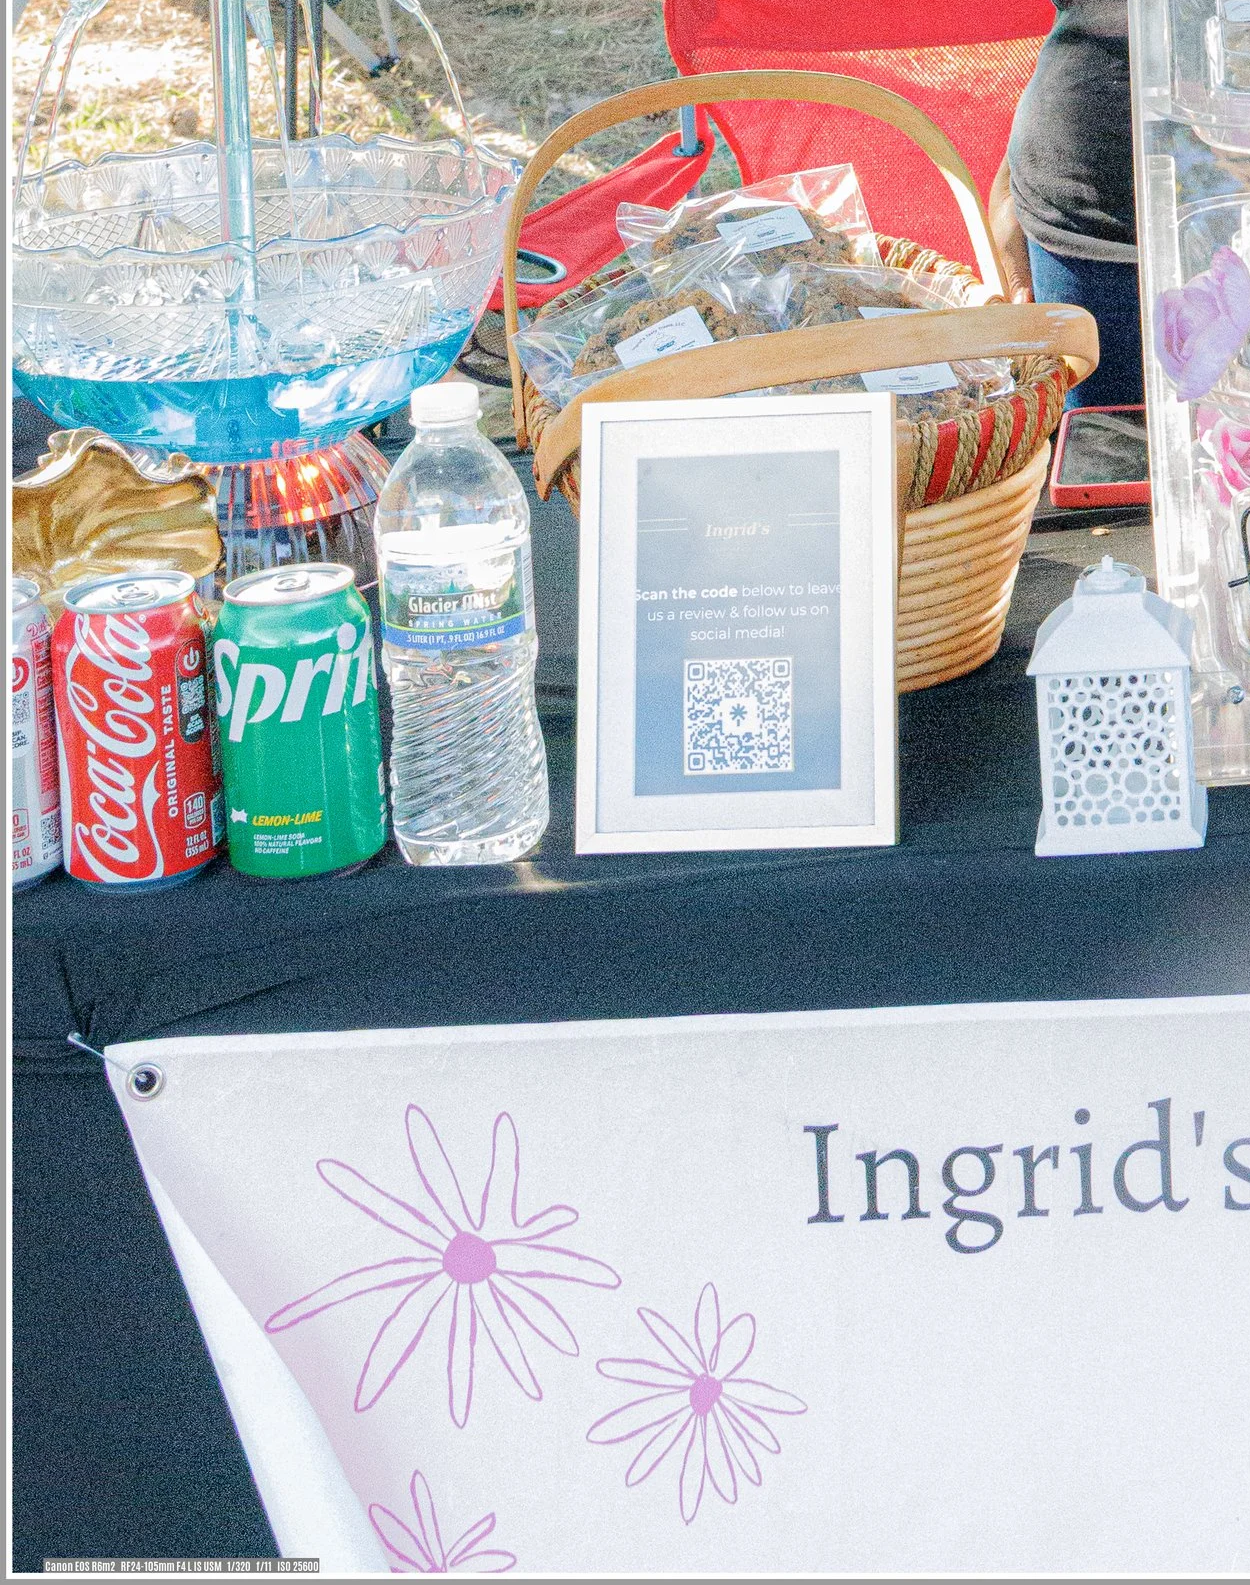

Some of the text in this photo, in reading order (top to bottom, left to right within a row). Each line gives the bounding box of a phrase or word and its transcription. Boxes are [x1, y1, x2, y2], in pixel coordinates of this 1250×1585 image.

[704, 521, 771, 540] Ingrid's
[671, 586, 697, 600] the
[700, 585, 739, 599] code
[741, 584, 785, 597] below
[788, 584, 804, 597] to
[807, 582, 840, 595] leave
[408, 596, 458, 614] Glacier
[647, 604, 829, 622] us a review & follow us on
[408, 612, 503, 628] SPRING WATER
[690, 625, 785, 641] social media!
[214, 620, 378, 742] Sprit
[67, 612, 164, 883] Coca-Cola
[160, 683, 180, 819] ORIGINAL TASTE
[186, 794, 204, 814] 140
[251, 809, 324, 827] LEMON-LIME
[253, 834, 288, 842] LEMON-LIME
[267, 840, 295, 848] NATURAL
